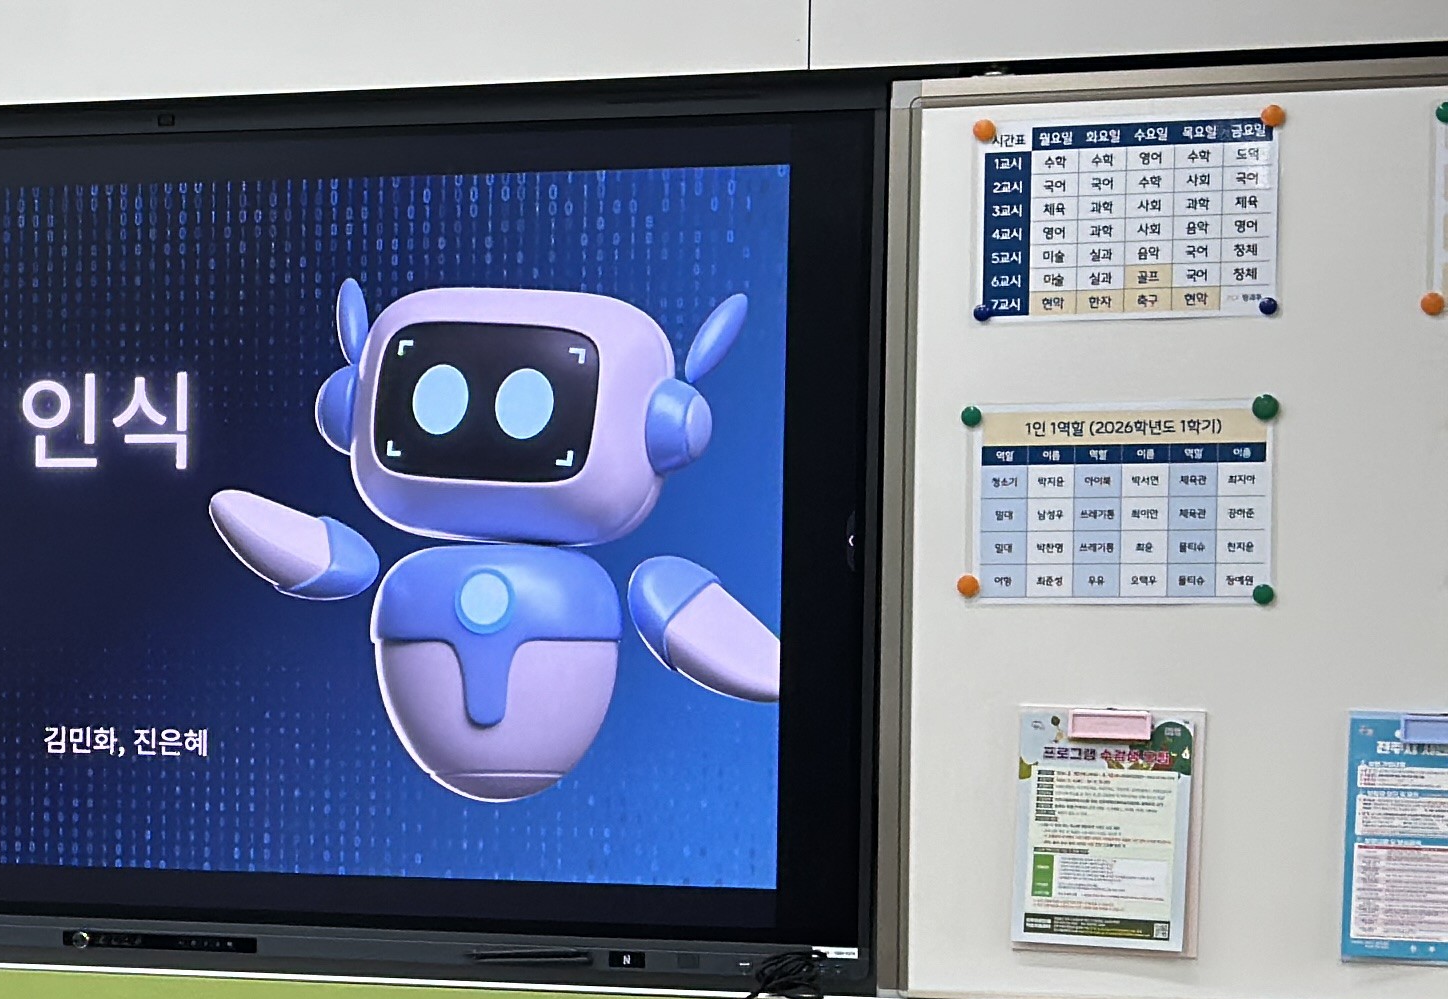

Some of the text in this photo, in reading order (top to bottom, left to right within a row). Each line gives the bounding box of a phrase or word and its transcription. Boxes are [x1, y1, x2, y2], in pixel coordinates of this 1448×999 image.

[1086, 130, 1120, 143] 화요일
[1134, 127, 1168, 141] 수요일
[1182, 125, 1217, 139] 목요일
[1231, 123, 1266, 138] 금요일
[992, 134, 1026, 147] 시간표
[1039, 131, 1072, 146] 월요일
[1044, 156, 1067, 168] 수학
[1092, 153, 1114, 167] 수학
[1139, 151, 1162, 165] 영어
[1187, 149, 1211, 162] 수학
[994, 157, 1022, 170] 1교시
[1092, 177, 1113, 190] 국어
[1139, 175, 1162, 188] 수학
[1186, 173, 1210, 186] 사회
[1236, 172, 1258, 184] 국어
[992, 181, 1022, 193] 2교시
[1044, 180, 1066, 192] 국어
[1091, 201, 1113, 214] 과학
[1137, 199, 1161, 212] 사회
[1186, 197, 1210, 210] 과학
[1235, 195, 1258, 208] 체육
[992, 204, 1022, 217] 3교시
[1043, 203, 1065, 216] 체육
[1090, 225, 1113, 238] 과학
[1137, 223, 1161, 236] 사회
[1186, 221, 1209, 235] 음악
[1235, 220, 1258, 233] 영어
[991, 228, 1022, 241] 4교시
[1043, 227, 1065, 240] 영어
[991, 251, 1022, 264] 5교시
[1043, 250, 1065, 263] 미술
[1090, 248, 1112, 262] 실과
[1137, 246, 1160, 260] 음악
[1185, 245, 1208, 258] 국어
[991, 275, 1021, 288] 6교시
[1044, 273, 1064, 287] 미술
[1089, 272, 1112, 285] 실과
[1186, 269, 1208, 282] 국어
[992, 298, 1021, 311] 7교시
[21, 372, 188, 470] 인식
[1025, 418, 1222, 437] 1인 1역할 (2026학년도 1학기)
[43, 726, 208, 758] 김민화, 진은혜
